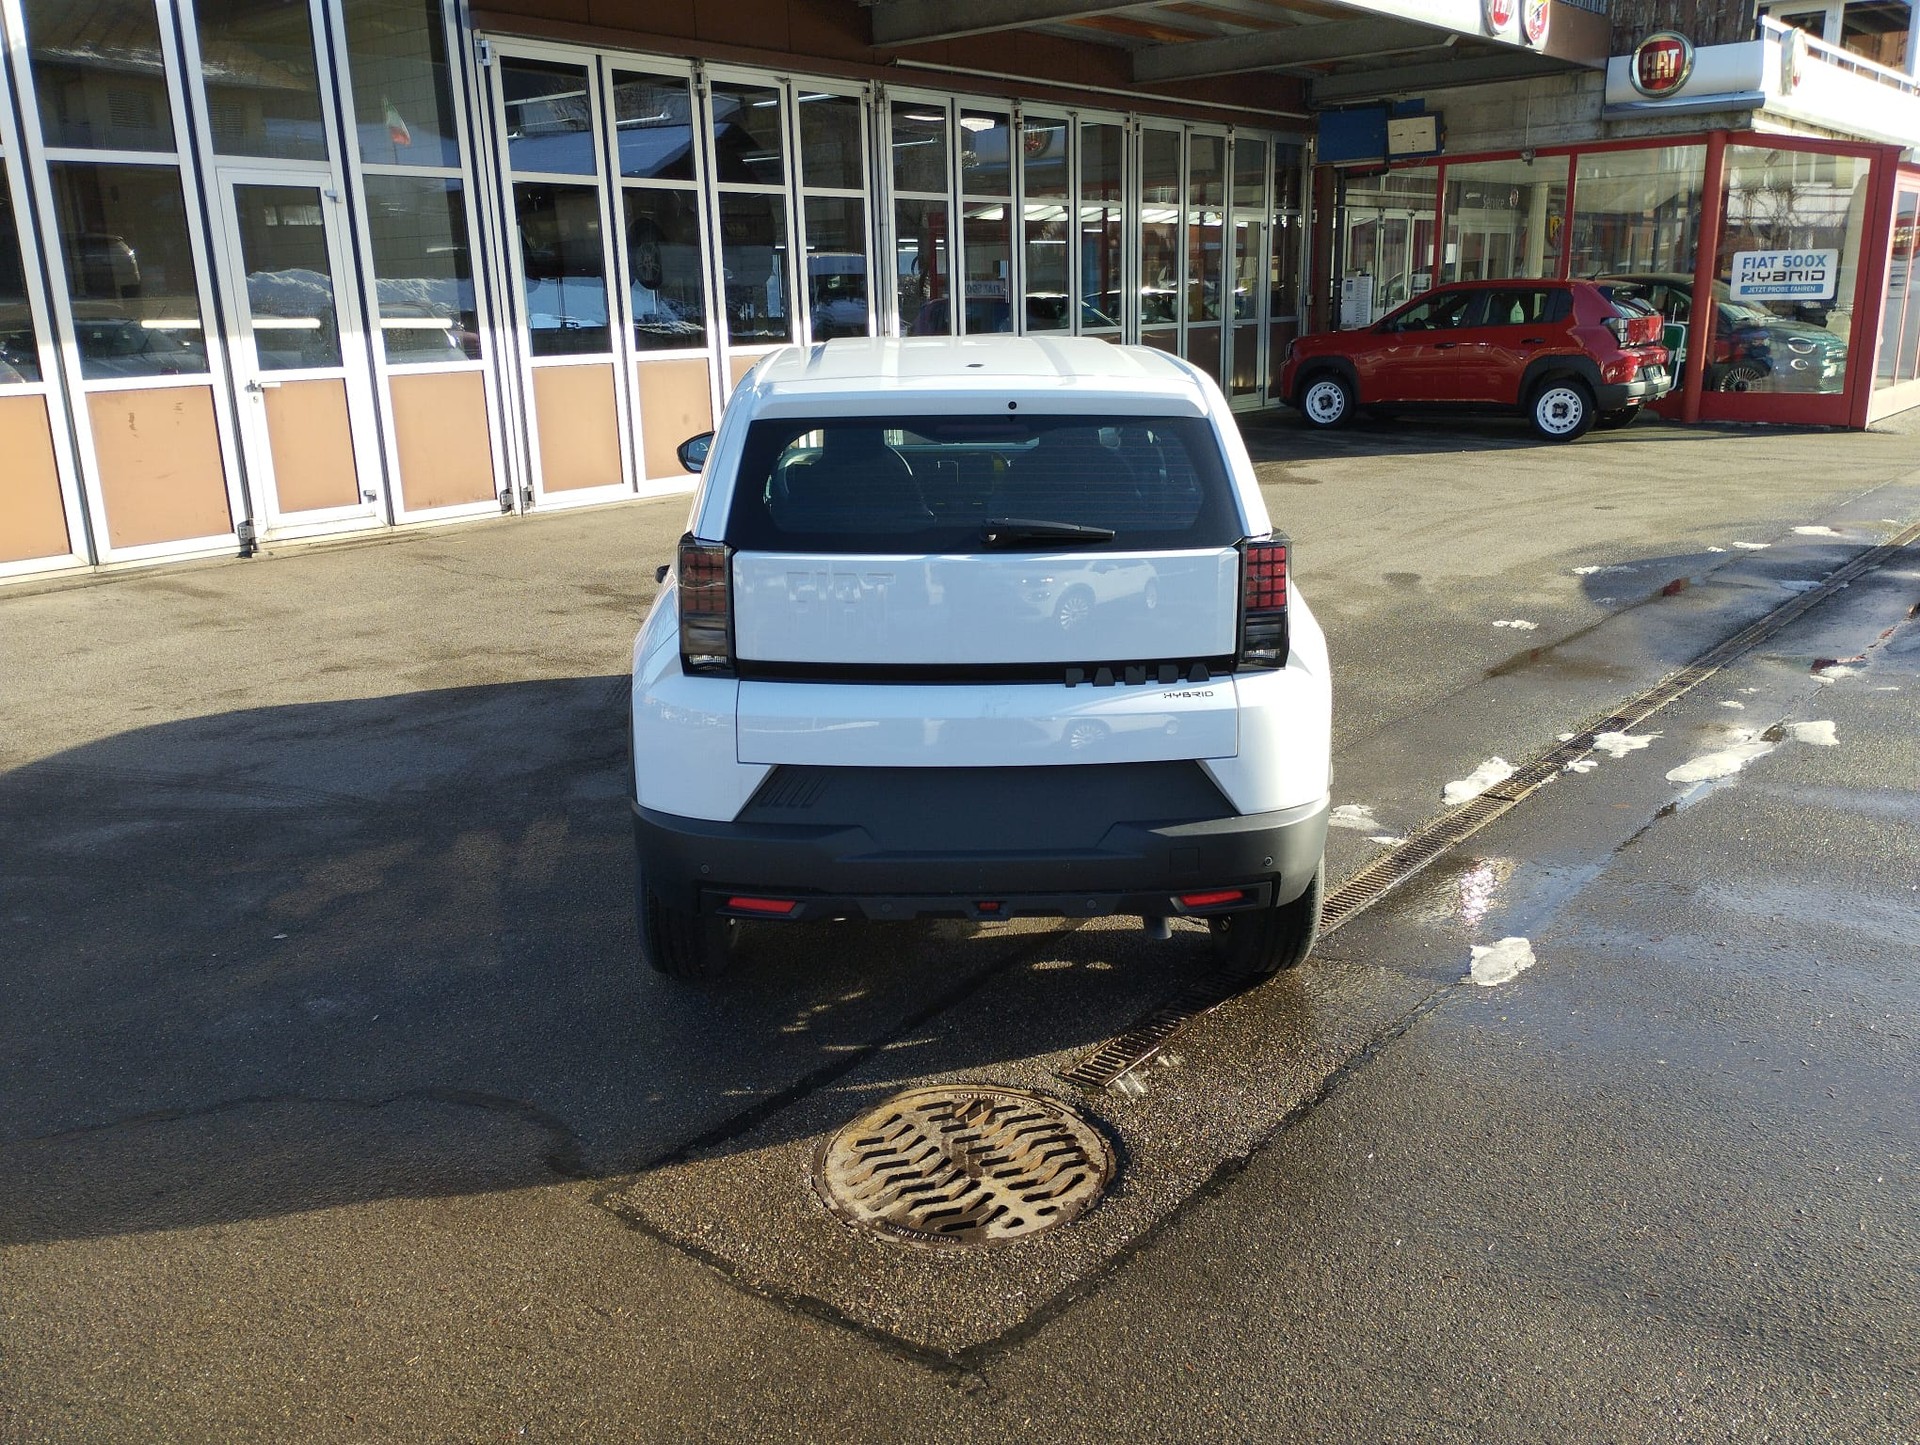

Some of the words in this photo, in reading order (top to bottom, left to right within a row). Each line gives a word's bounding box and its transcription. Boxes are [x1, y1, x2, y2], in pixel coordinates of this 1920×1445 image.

[1642, 48, 1680, 81] FIAT
[1743, 256, 1778, 269] FIAT
[1783, 255, 1827, 268] 500X
[1741, 270, 1825, 282] HYBRID
[1748, 285, 1766, 293] JETZT
[1767, 285, 1789, 293] PROBE
[1790, 284, 1816, 292] FAHREN
[1065, 663, 1210, 688] PANDA
[1163, 690, 1214, 699] HYBRID
